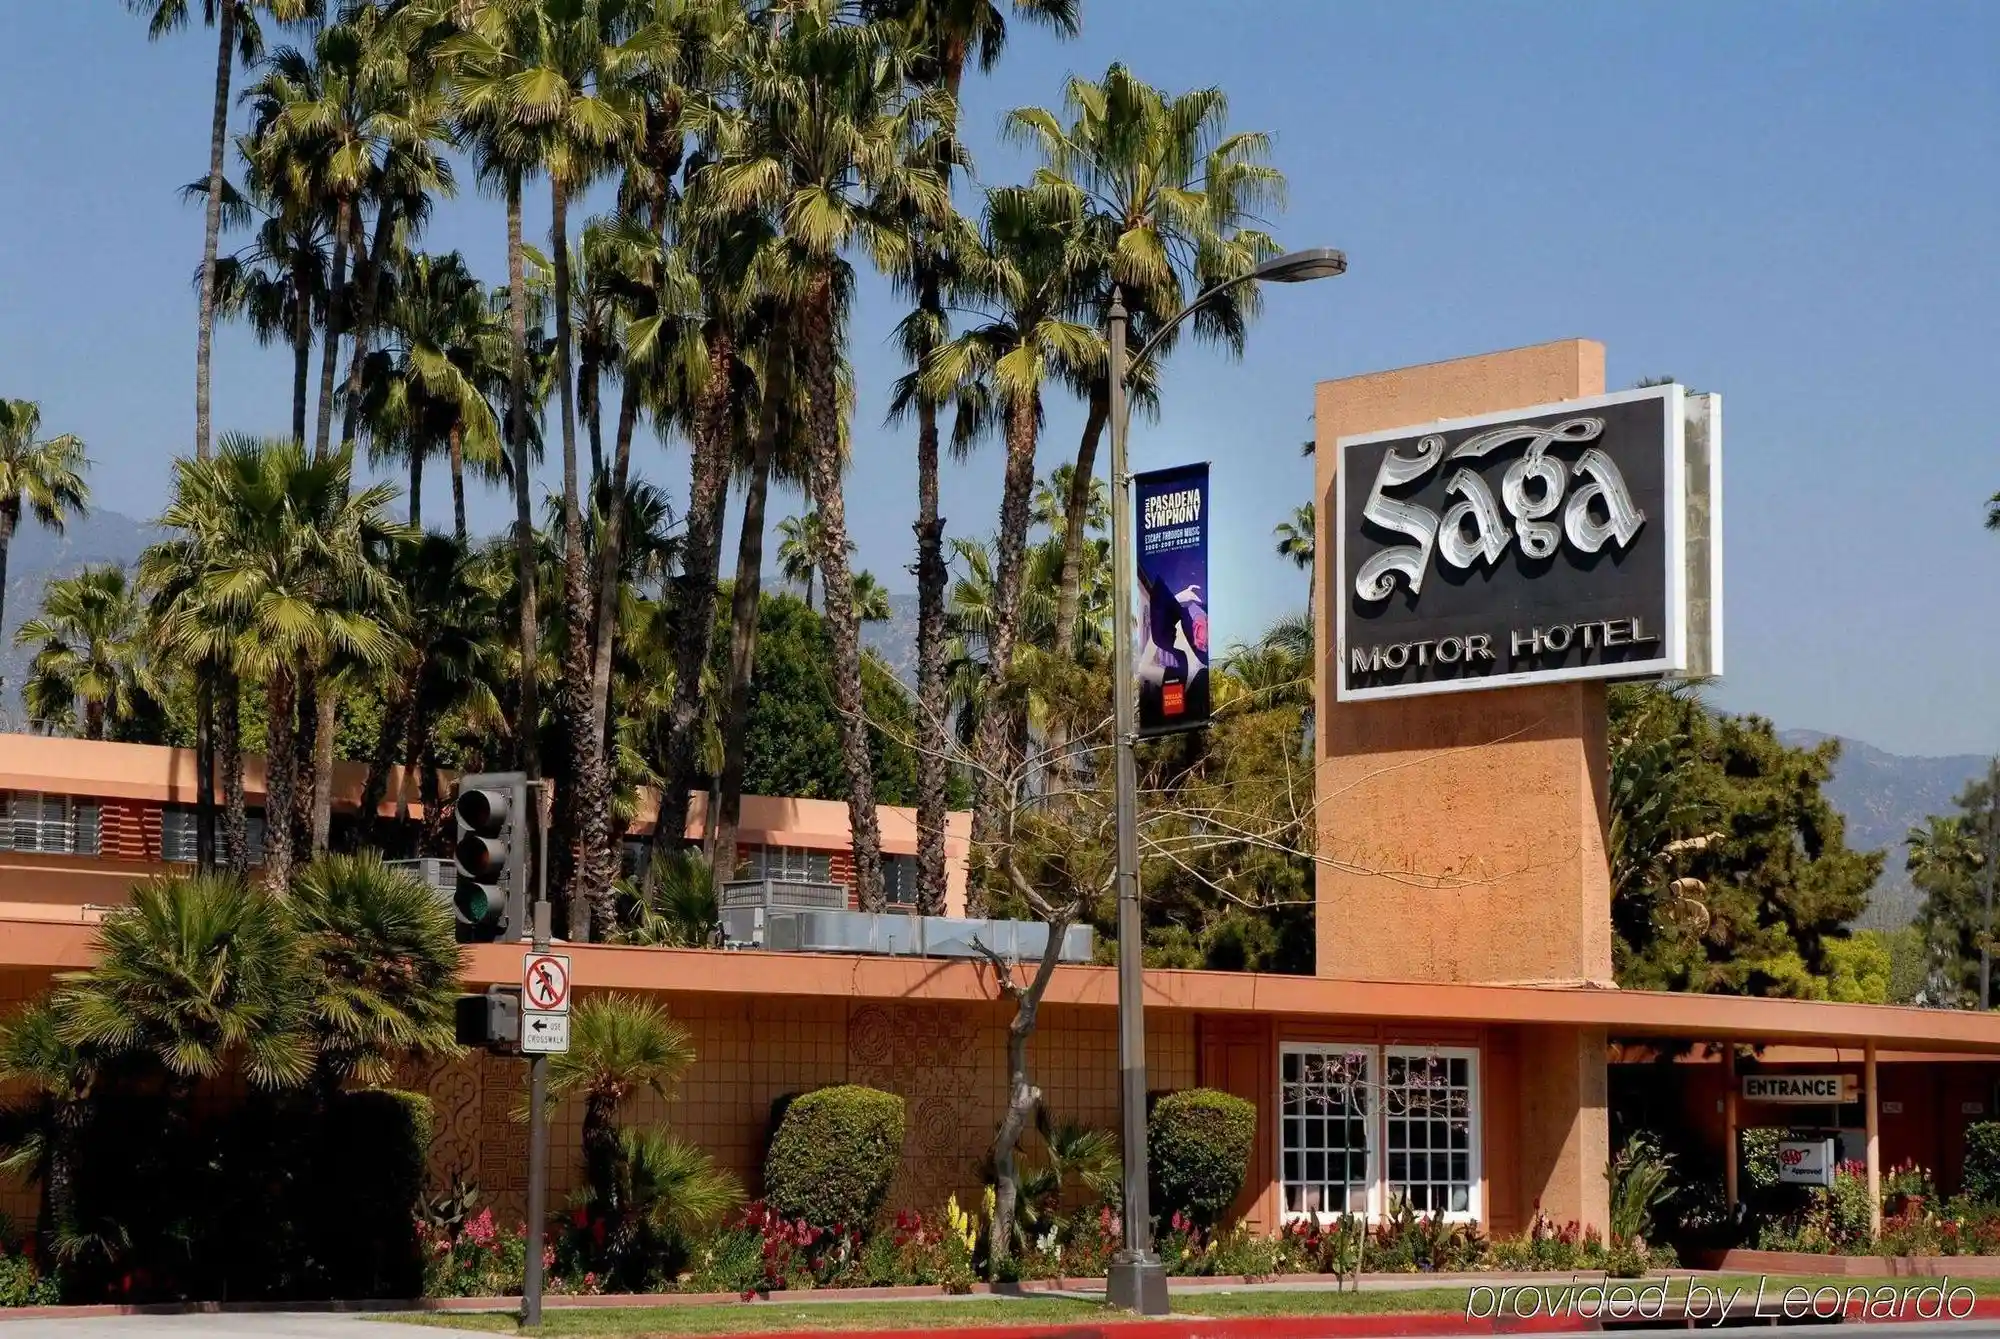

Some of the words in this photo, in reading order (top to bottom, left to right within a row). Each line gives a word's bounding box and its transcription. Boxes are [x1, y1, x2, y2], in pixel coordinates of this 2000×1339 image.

[1150, 488, 1200, 511] PASADENA
[1144, 504, 1200, 529] SYMPHONY
[1356, 417, 1646, 601] Saga
[1184, 526, 1200, 537] MUSIC
[1351, 633, 1497, 674] MOTOR
[1511, 617, 1660, 657] HOTEL
[550, 1022, 561, 1031] USE
[1747, 1080, 1836, 1096] ENTRANCE
[1782, 1150, 1799, 1164] AAA
[1792, 1167, 1823, 1176] Approved
